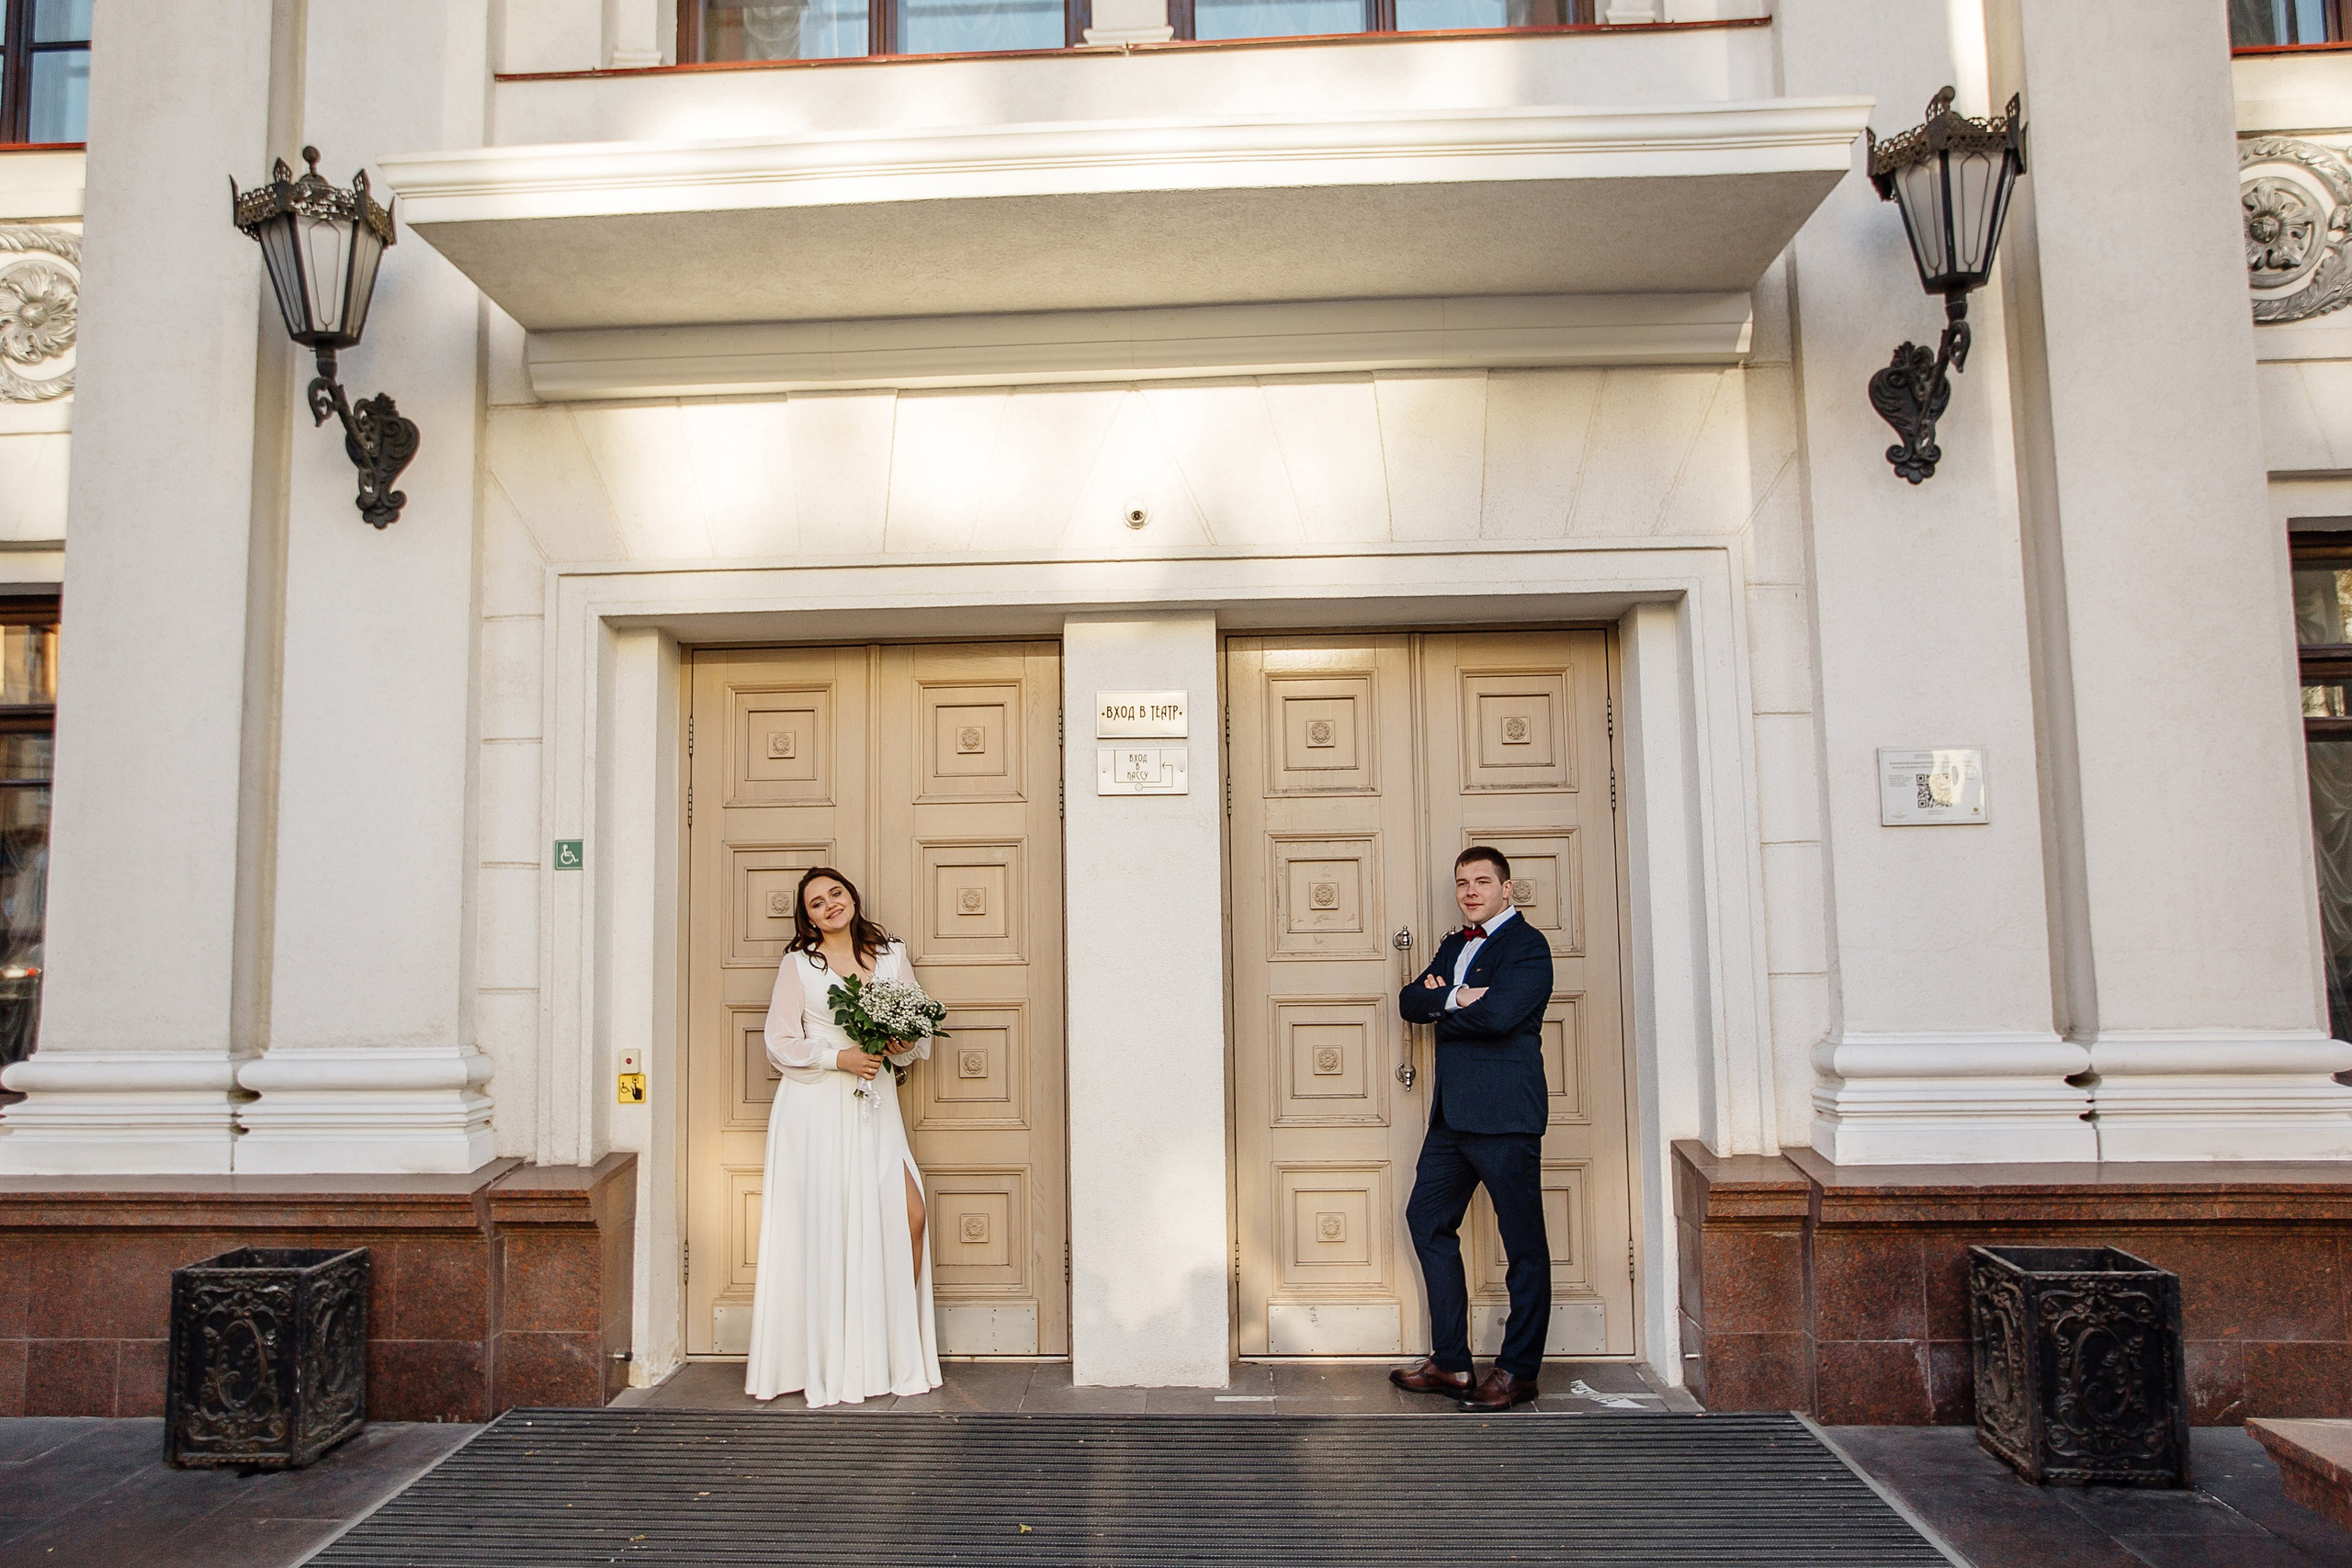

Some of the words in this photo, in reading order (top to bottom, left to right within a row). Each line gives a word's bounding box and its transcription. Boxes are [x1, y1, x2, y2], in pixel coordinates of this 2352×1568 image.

[1106, 705, 1136, 721] ВХОД
[1139, 705, 1147, 718] В
[1150, 705, 1179, 721] ТЕАТР
[1129, 753, 1148, 763] ВХОД
[1136, 762, 1140, 771] В
[1127, 771, 1148, 781] КАССУ
